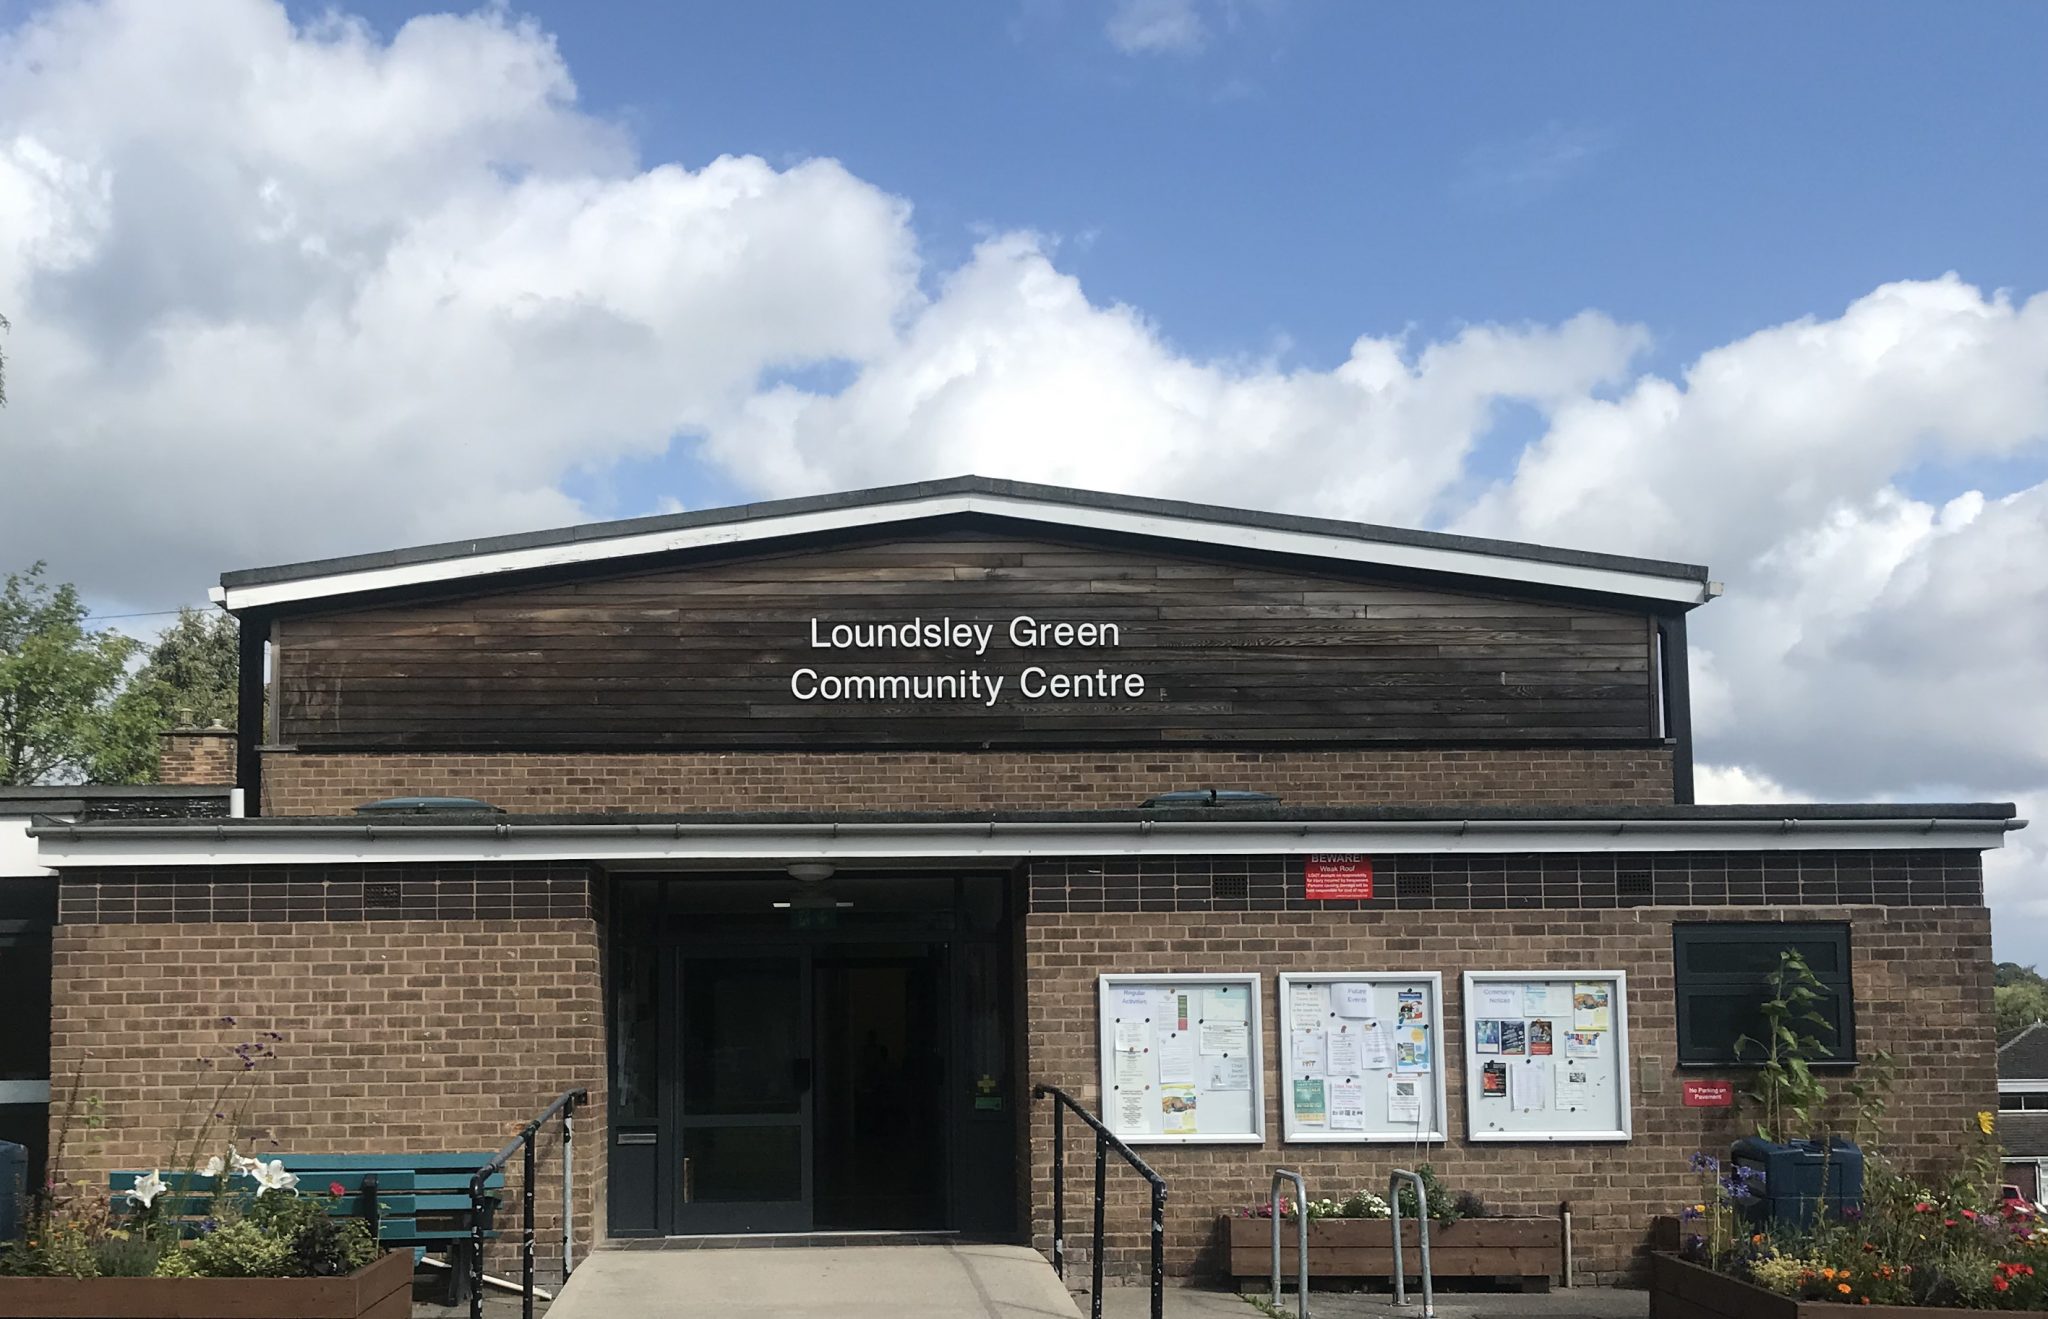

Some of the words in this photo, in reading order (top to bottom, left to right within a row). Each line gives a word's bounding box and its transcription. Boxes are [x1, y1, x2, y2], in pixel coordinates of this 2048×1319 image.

[811, 616, 993, 654] Loundsley
[1008, 615, 1119, 646] Green
[790, 667, 1004, 706] Community
[1019, 666, 1144, 698] Centre
